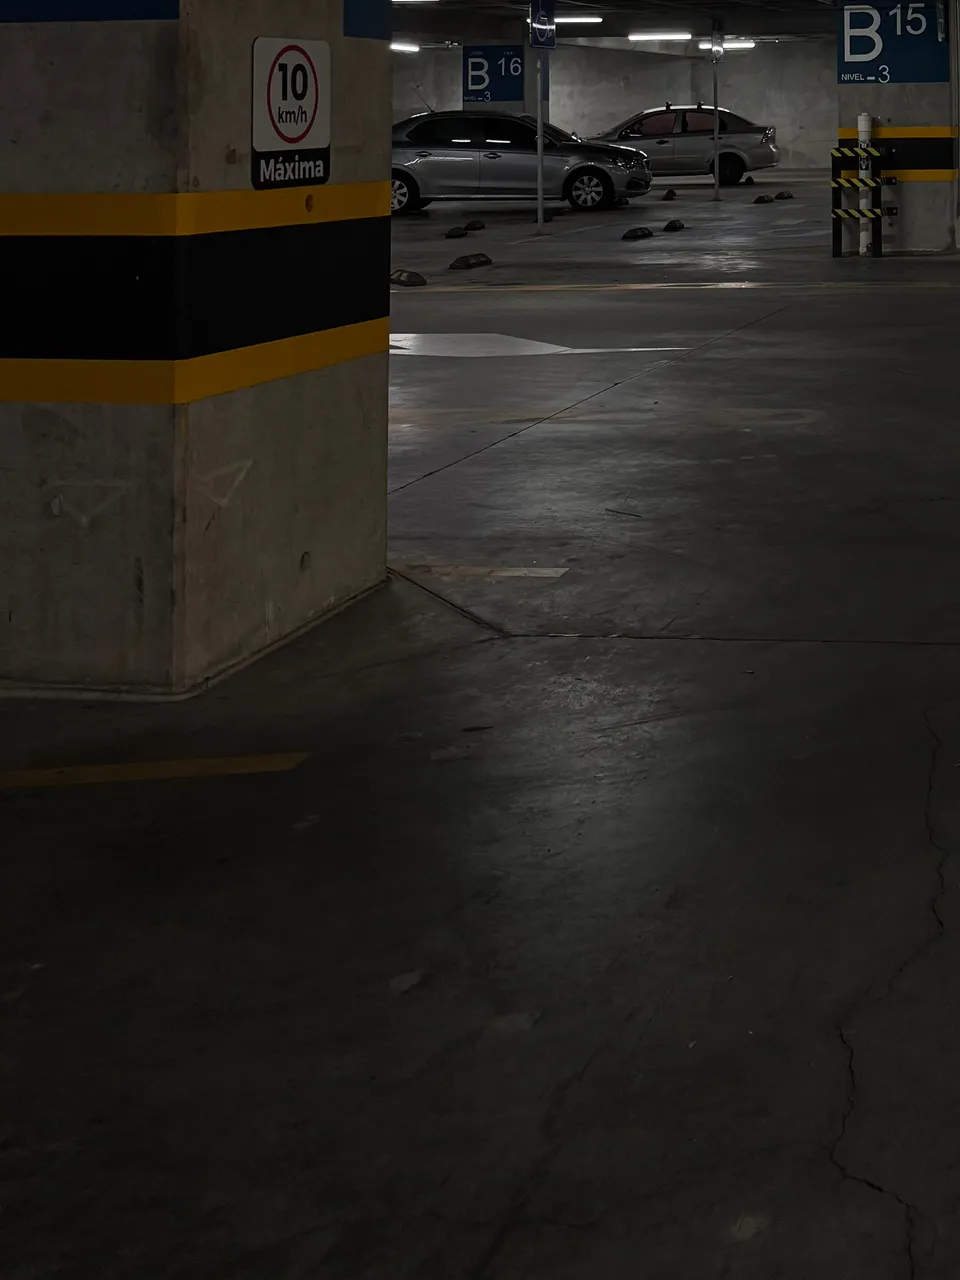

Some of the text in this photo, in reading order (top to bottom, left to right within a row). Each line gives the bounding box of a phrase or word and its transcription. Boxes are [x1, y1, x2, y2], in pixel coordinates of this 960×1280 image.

[843, 3, 927, 62] B 15
[278, 63, 308, 101] 10
[468, 57, 522, 90] B 16
[841, 73, 865, 81] NIVEL
[278, 105, 308, 125] km/h
[260, 154, 324, 183] Máxima
